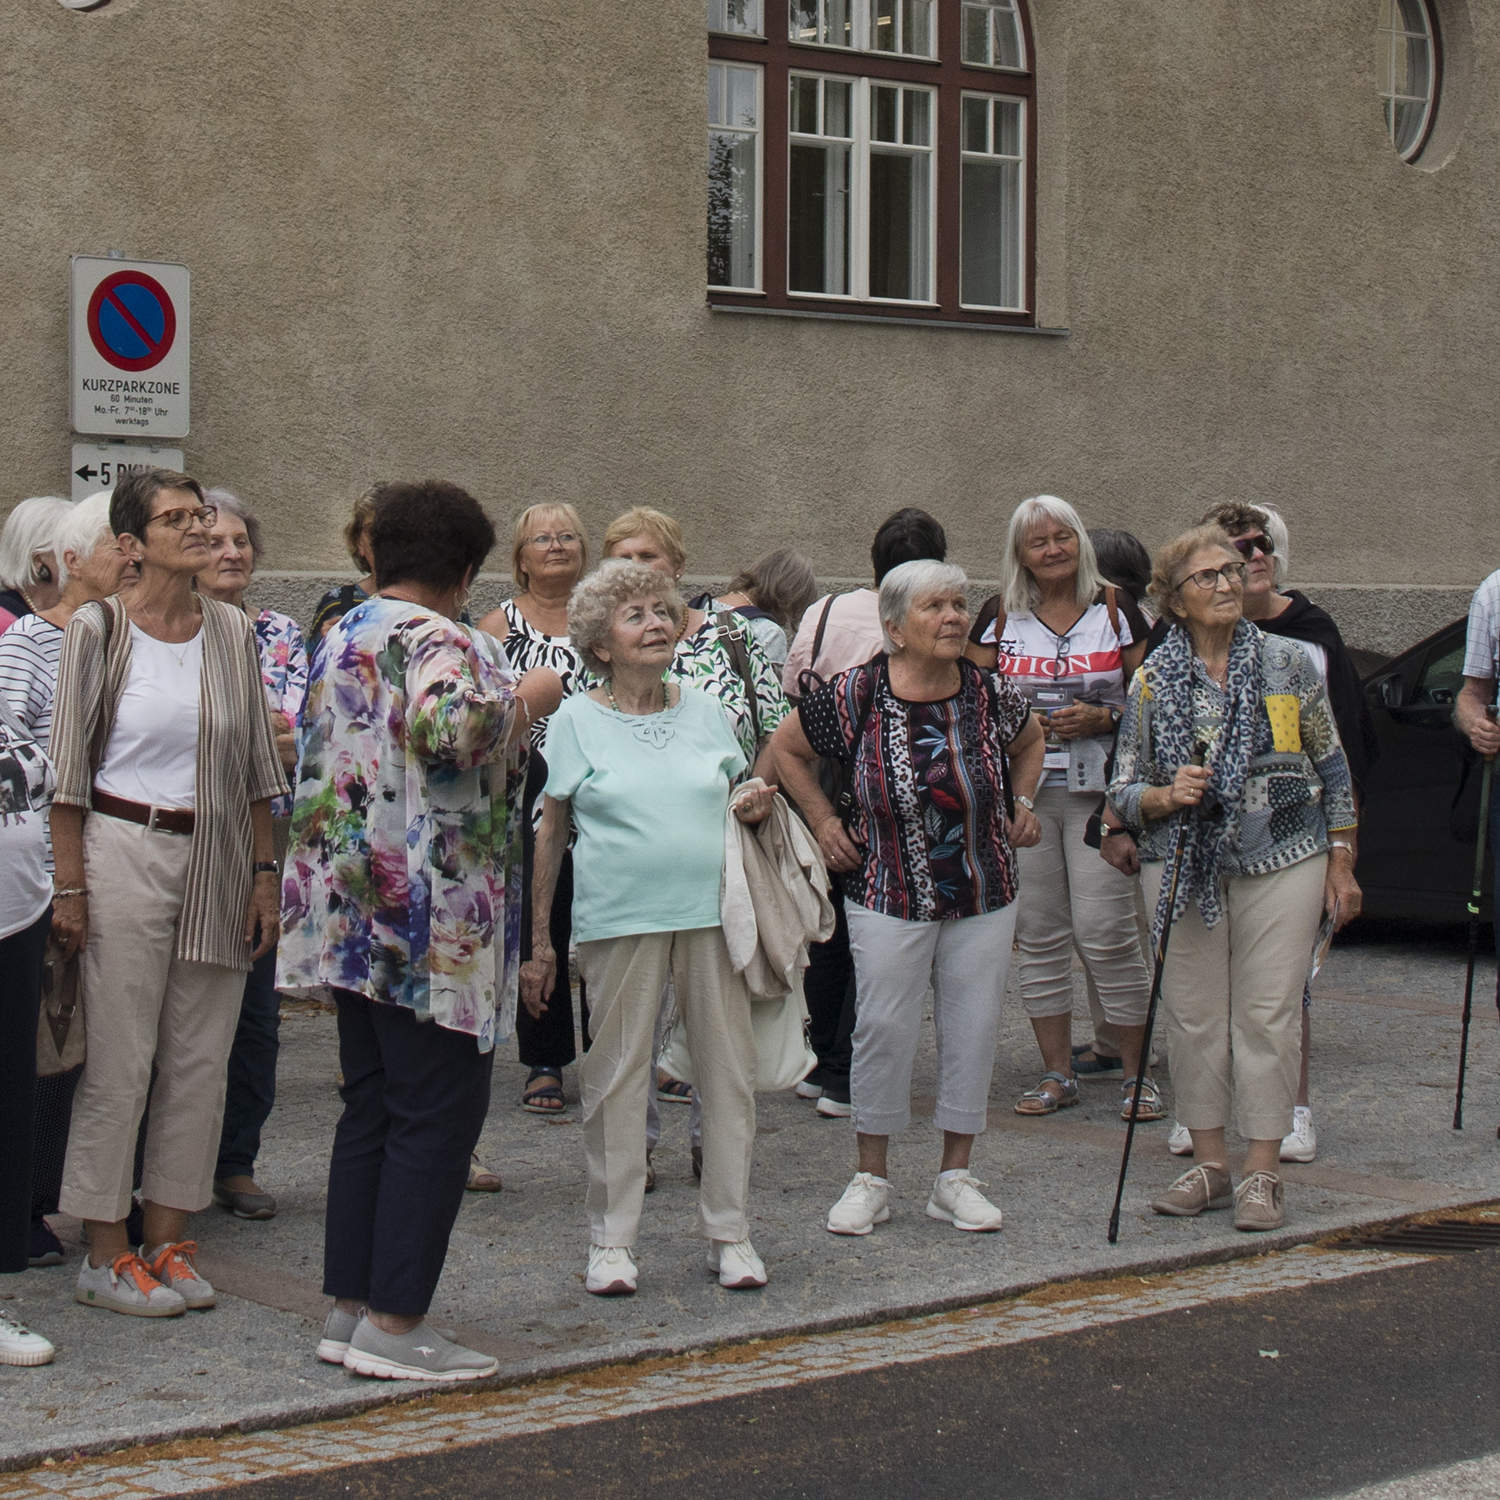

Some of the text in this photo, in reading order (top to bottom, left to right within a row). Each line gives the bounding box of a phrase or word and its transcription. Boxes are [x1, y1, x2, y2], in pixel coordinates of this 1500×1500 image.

[82, 379, 180, 394] KURZPARKZONE
[110, 394, 153, 404] 60 Minuten
[154, 407, 169, 417] Uhr
[115, 417, 149, 427] werktags
[101, 462, 111, 486] 5
